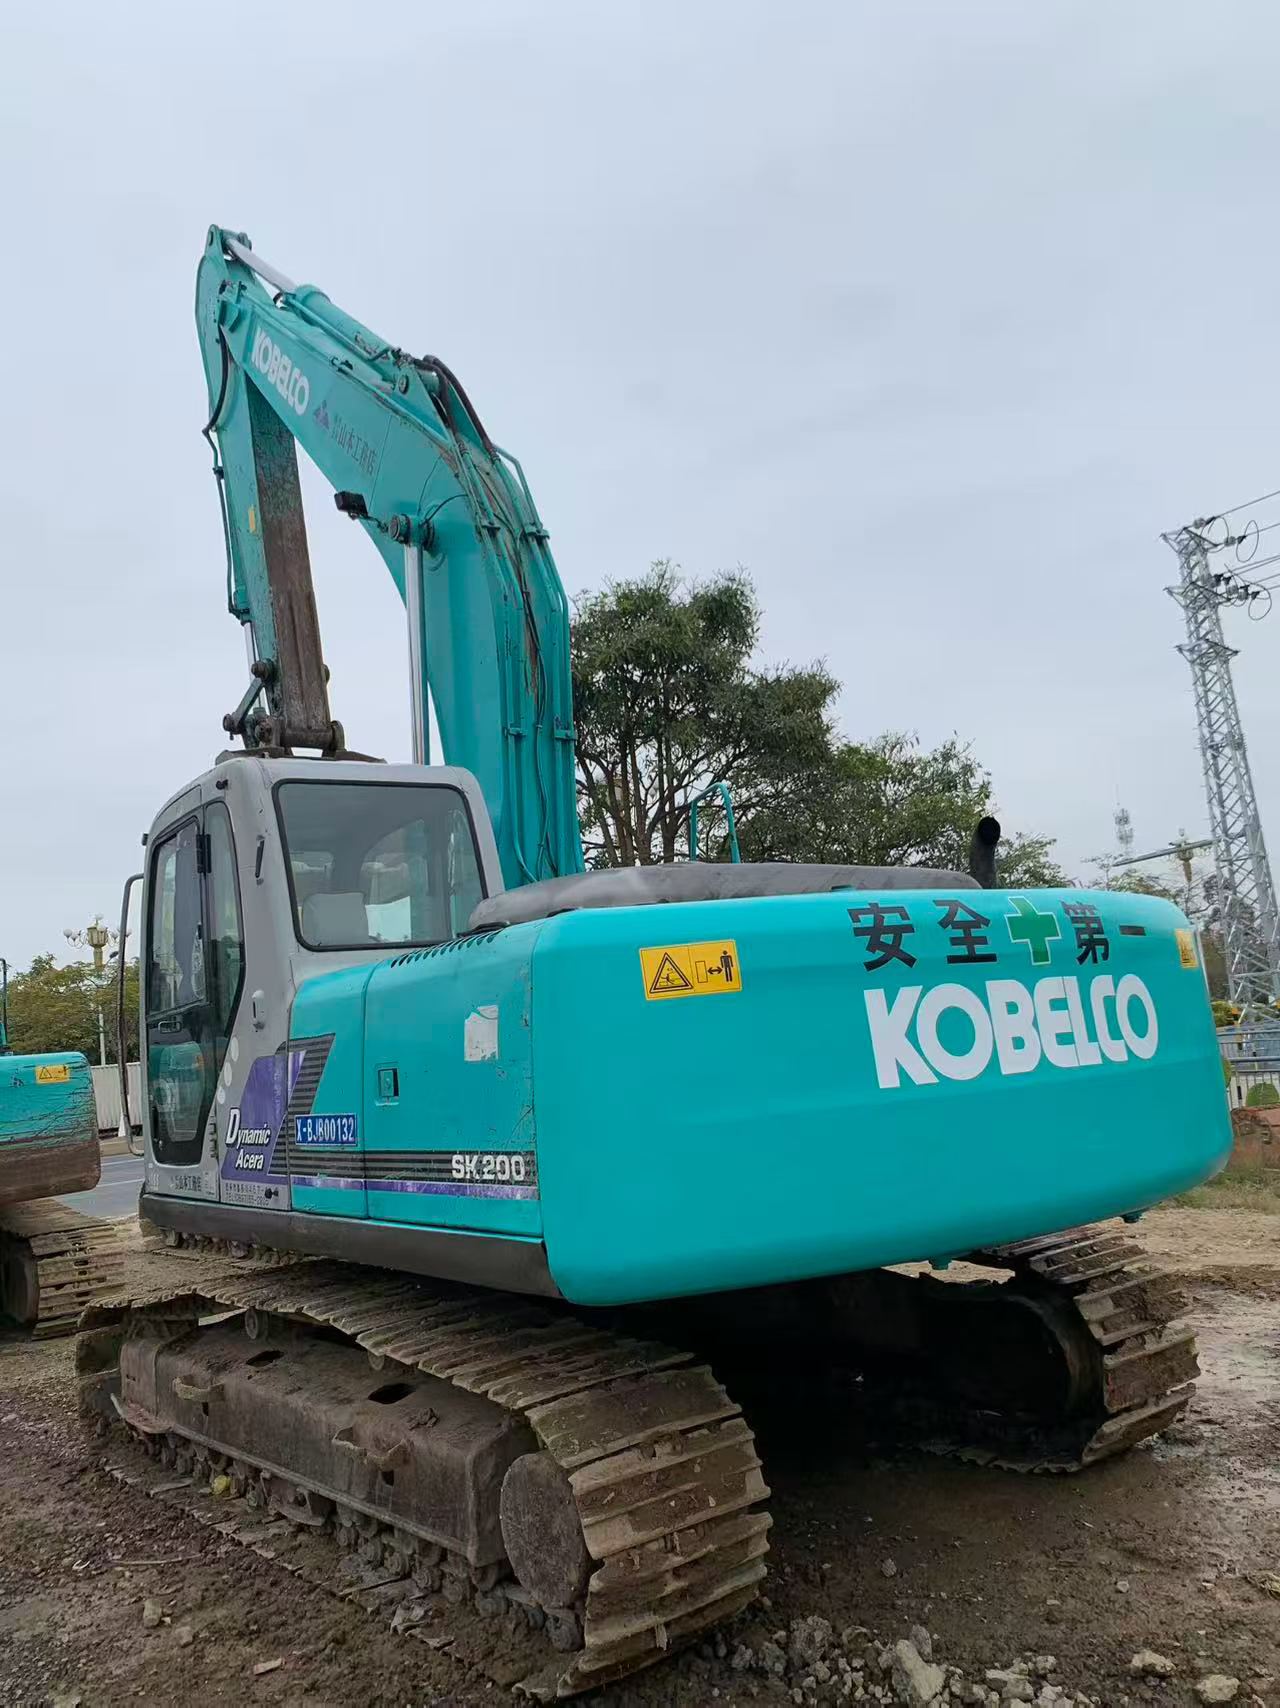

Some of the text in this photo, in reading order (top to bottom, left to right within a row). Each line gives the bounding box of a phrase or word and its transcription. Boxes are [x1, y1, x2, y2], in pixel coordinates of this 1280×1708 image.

[251, 325, 310, 416] KOBELCO
[863, 973, 1159, 1089] KOBELCO
[225, 1107, 271, 1149] Dynamic
[296, 1117, 354, 1142] X-BJB00132
[235, 1148, 264, 1170] Acera
